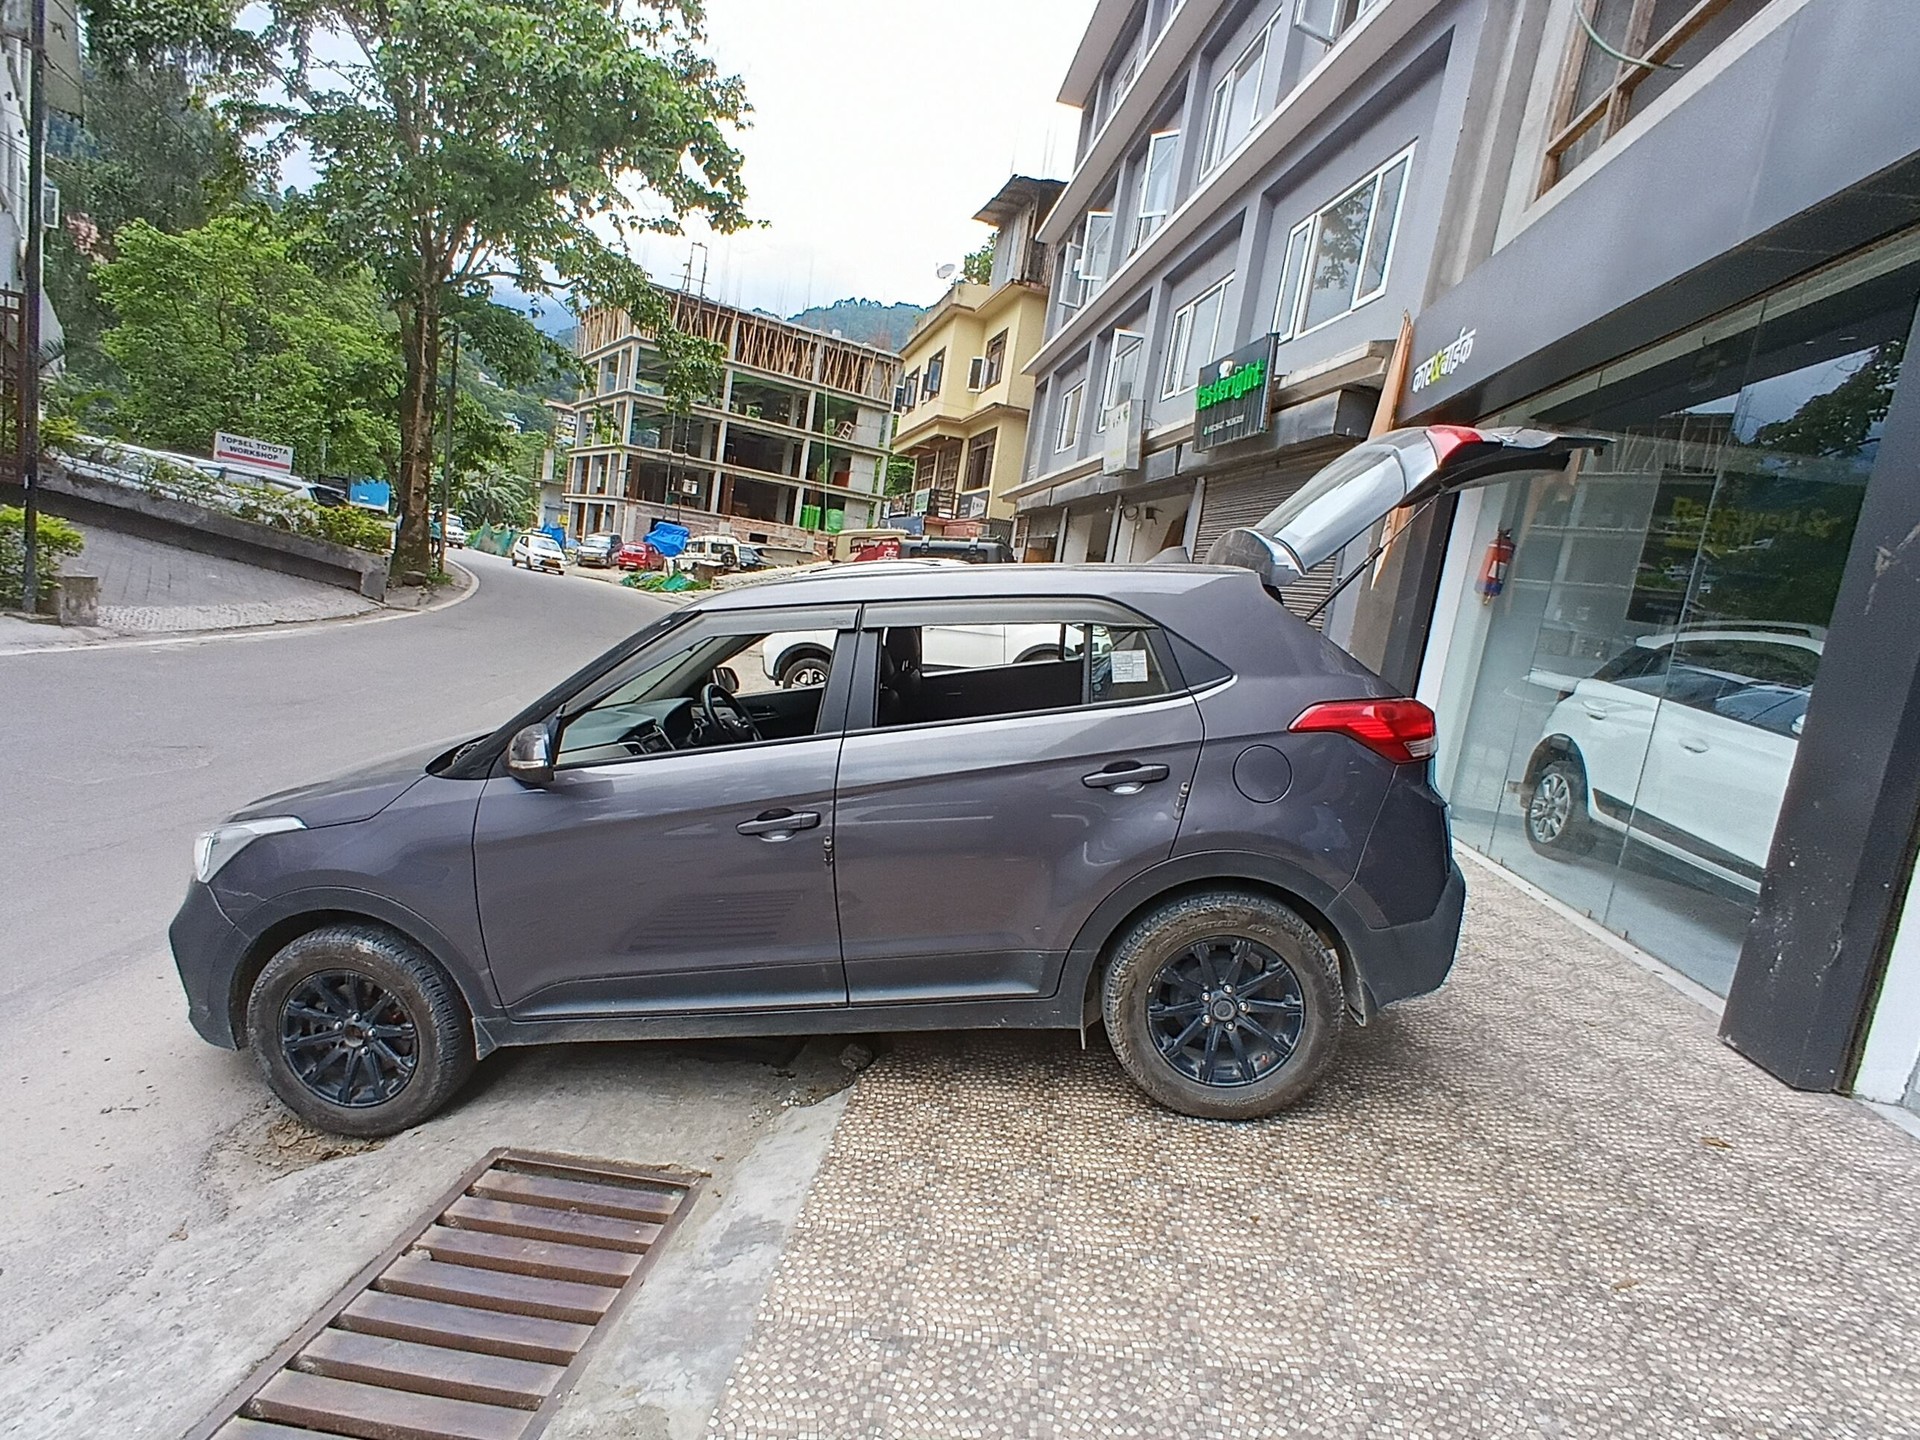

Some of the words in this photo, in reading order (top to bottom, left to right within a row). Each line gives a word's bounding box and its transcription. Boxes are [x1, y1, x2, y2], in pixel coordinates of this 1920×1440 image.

[221, 435, 254, 448] TOPSEL
[256, 442, 289, 455] TOYOTA
[229, 445, 279, 461] WORKSHOP
